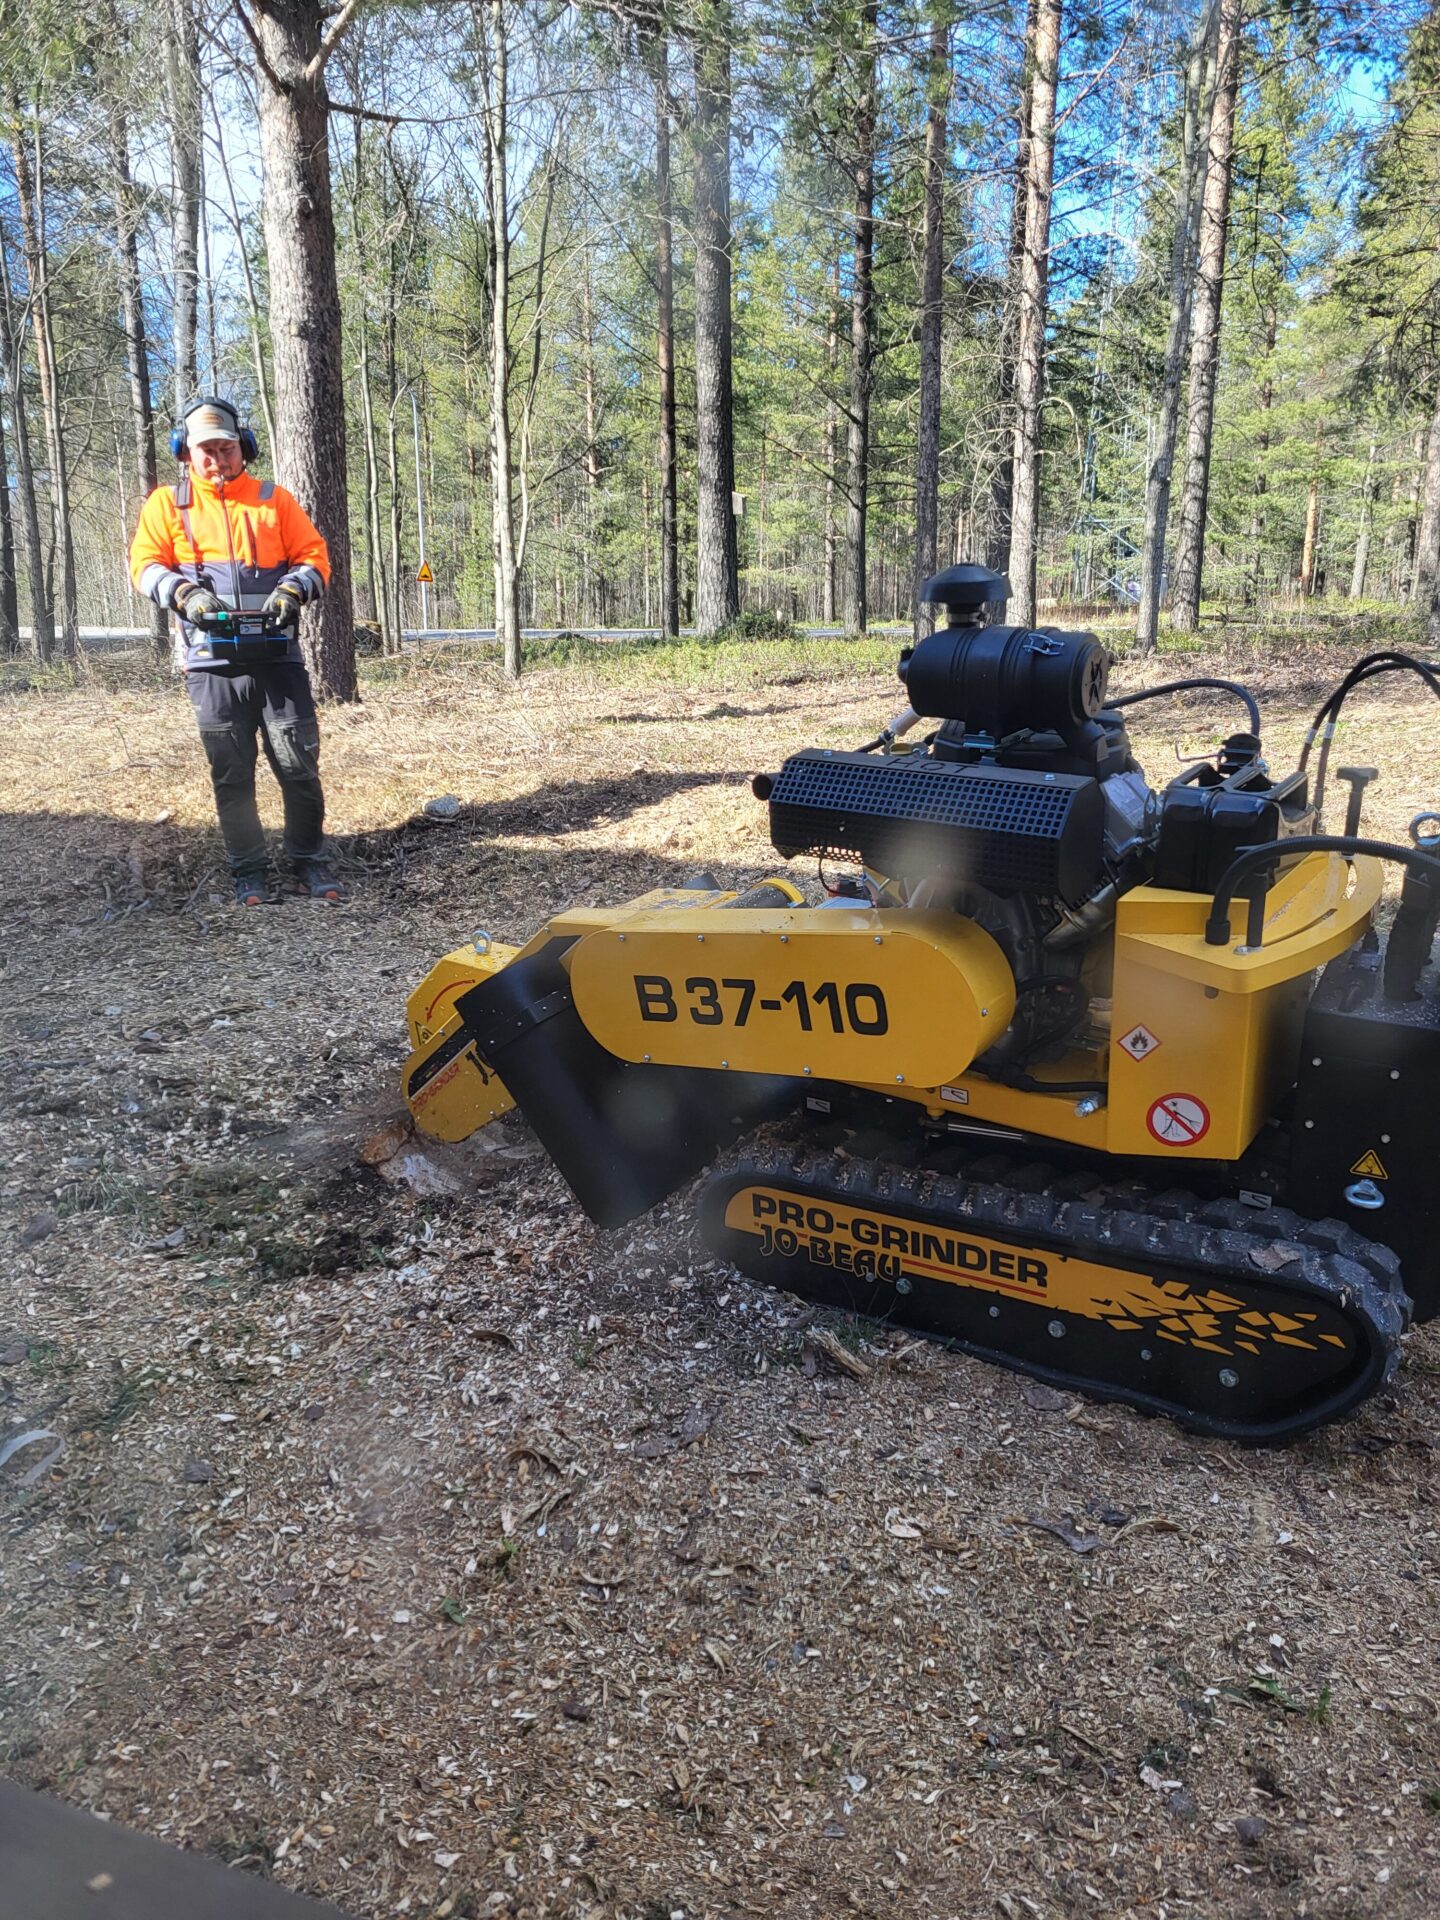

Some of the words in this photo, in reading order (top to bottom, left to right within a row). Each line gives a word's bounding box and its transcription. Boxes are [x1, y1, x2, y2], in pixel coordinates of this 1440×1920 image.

[886, 758, 979, 774] HOT
[634, 975, 678, 1022] B
[685, 976, 888, 1036] 37-110
[752, 1194, 1048, 1288] PRO-GRINDER
[760, 1223, 800, 1257] JO
[808, 1235, 903, 1284] BEAU
